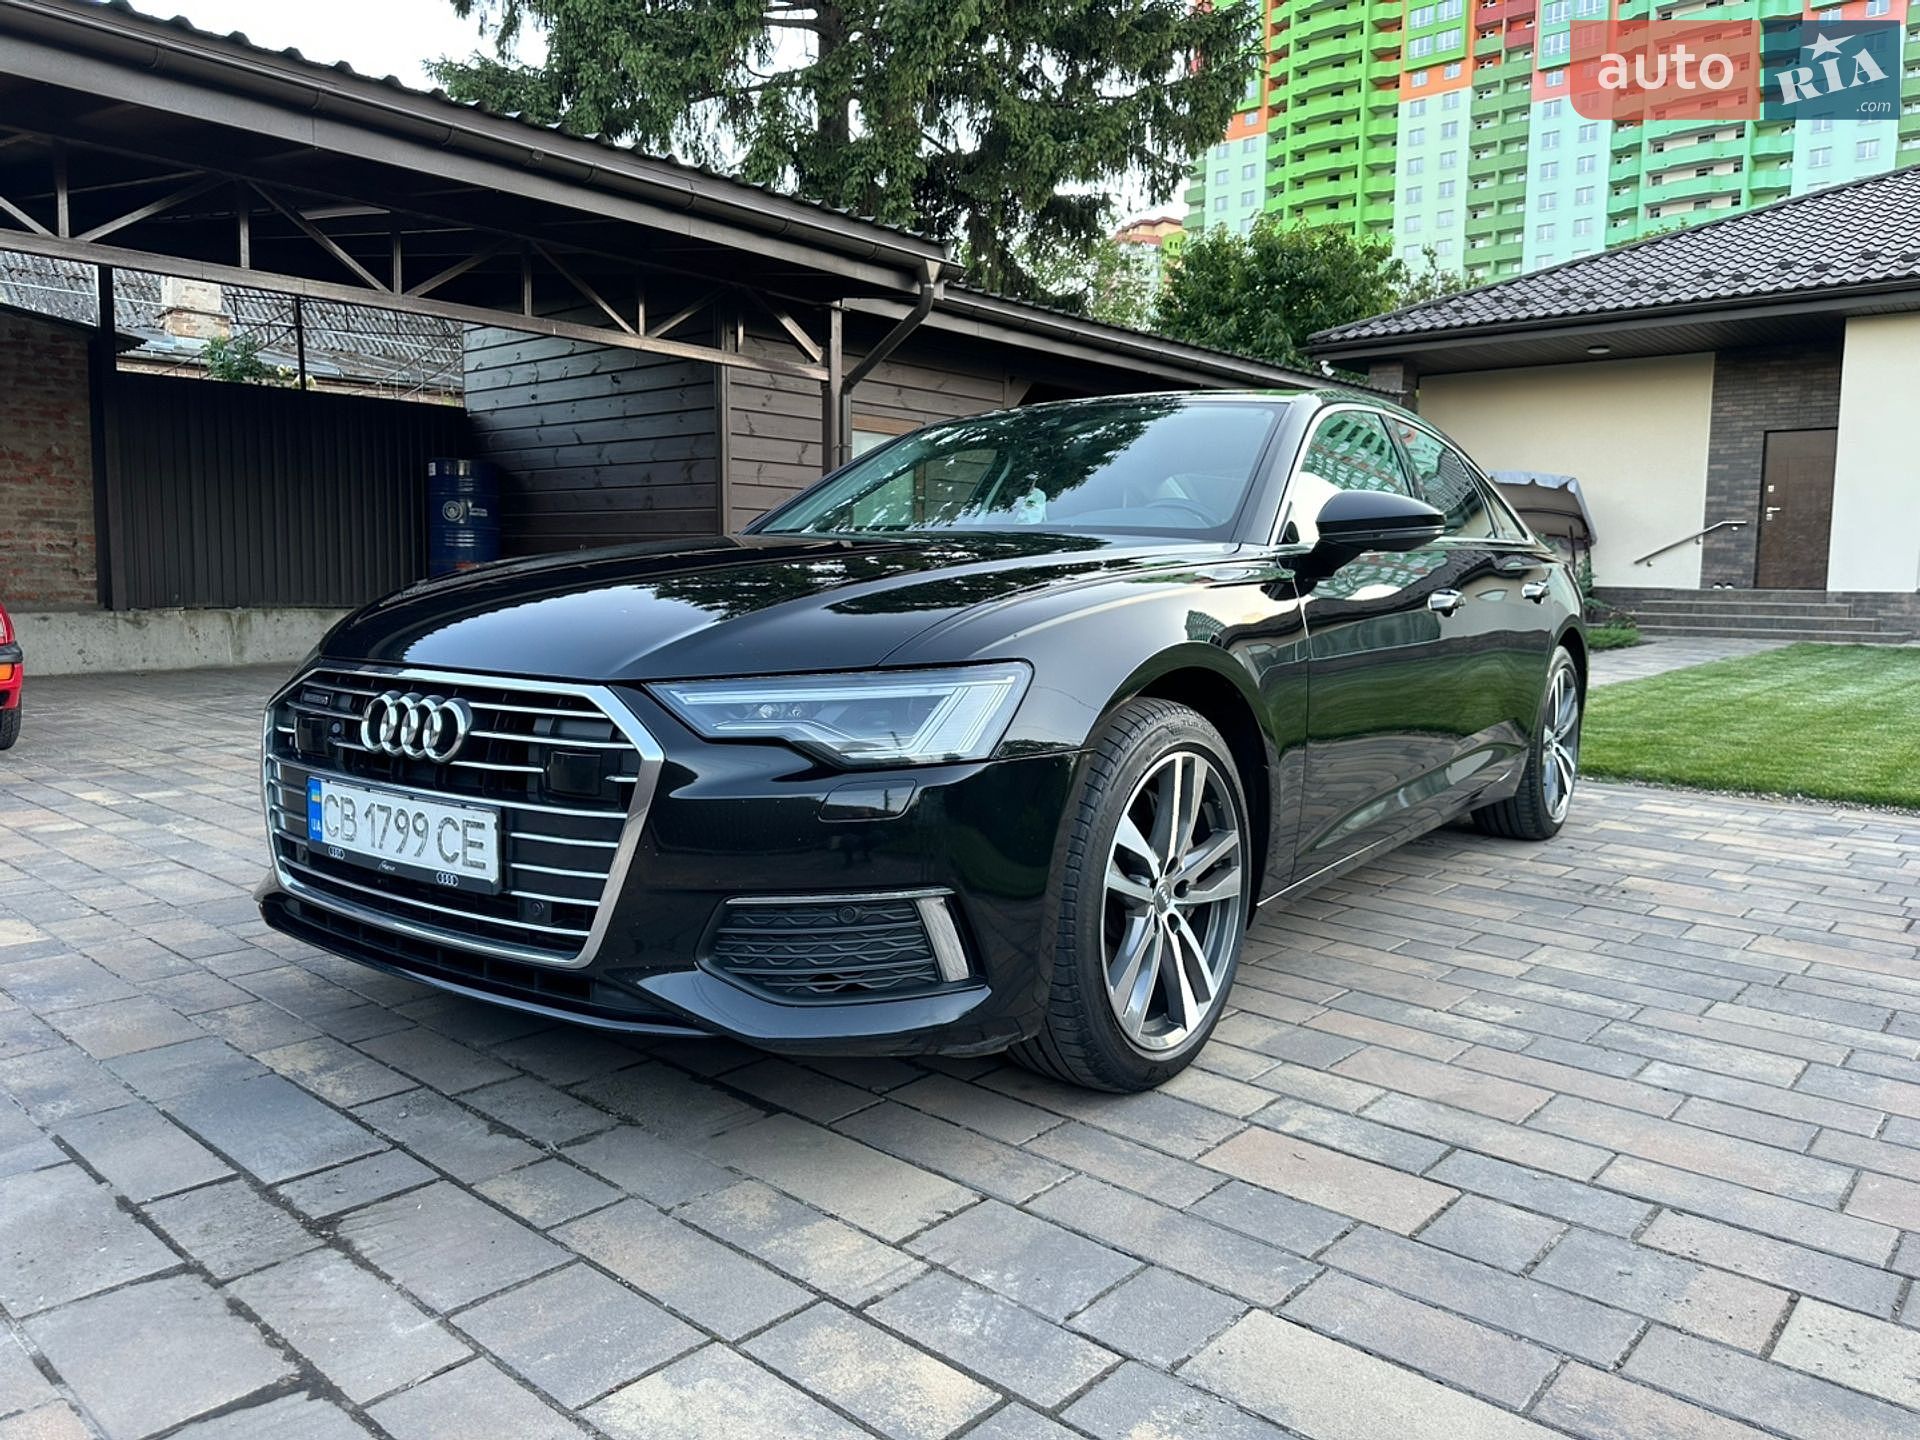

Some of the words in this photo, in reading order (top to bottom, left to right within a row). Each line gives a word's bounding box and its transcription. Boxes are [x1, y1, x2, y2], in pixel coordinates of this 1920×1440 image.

[323, 793, 358, 843] CB
[364, 802, 429, 858] 1799
[437, 816, 487, 870] CE
